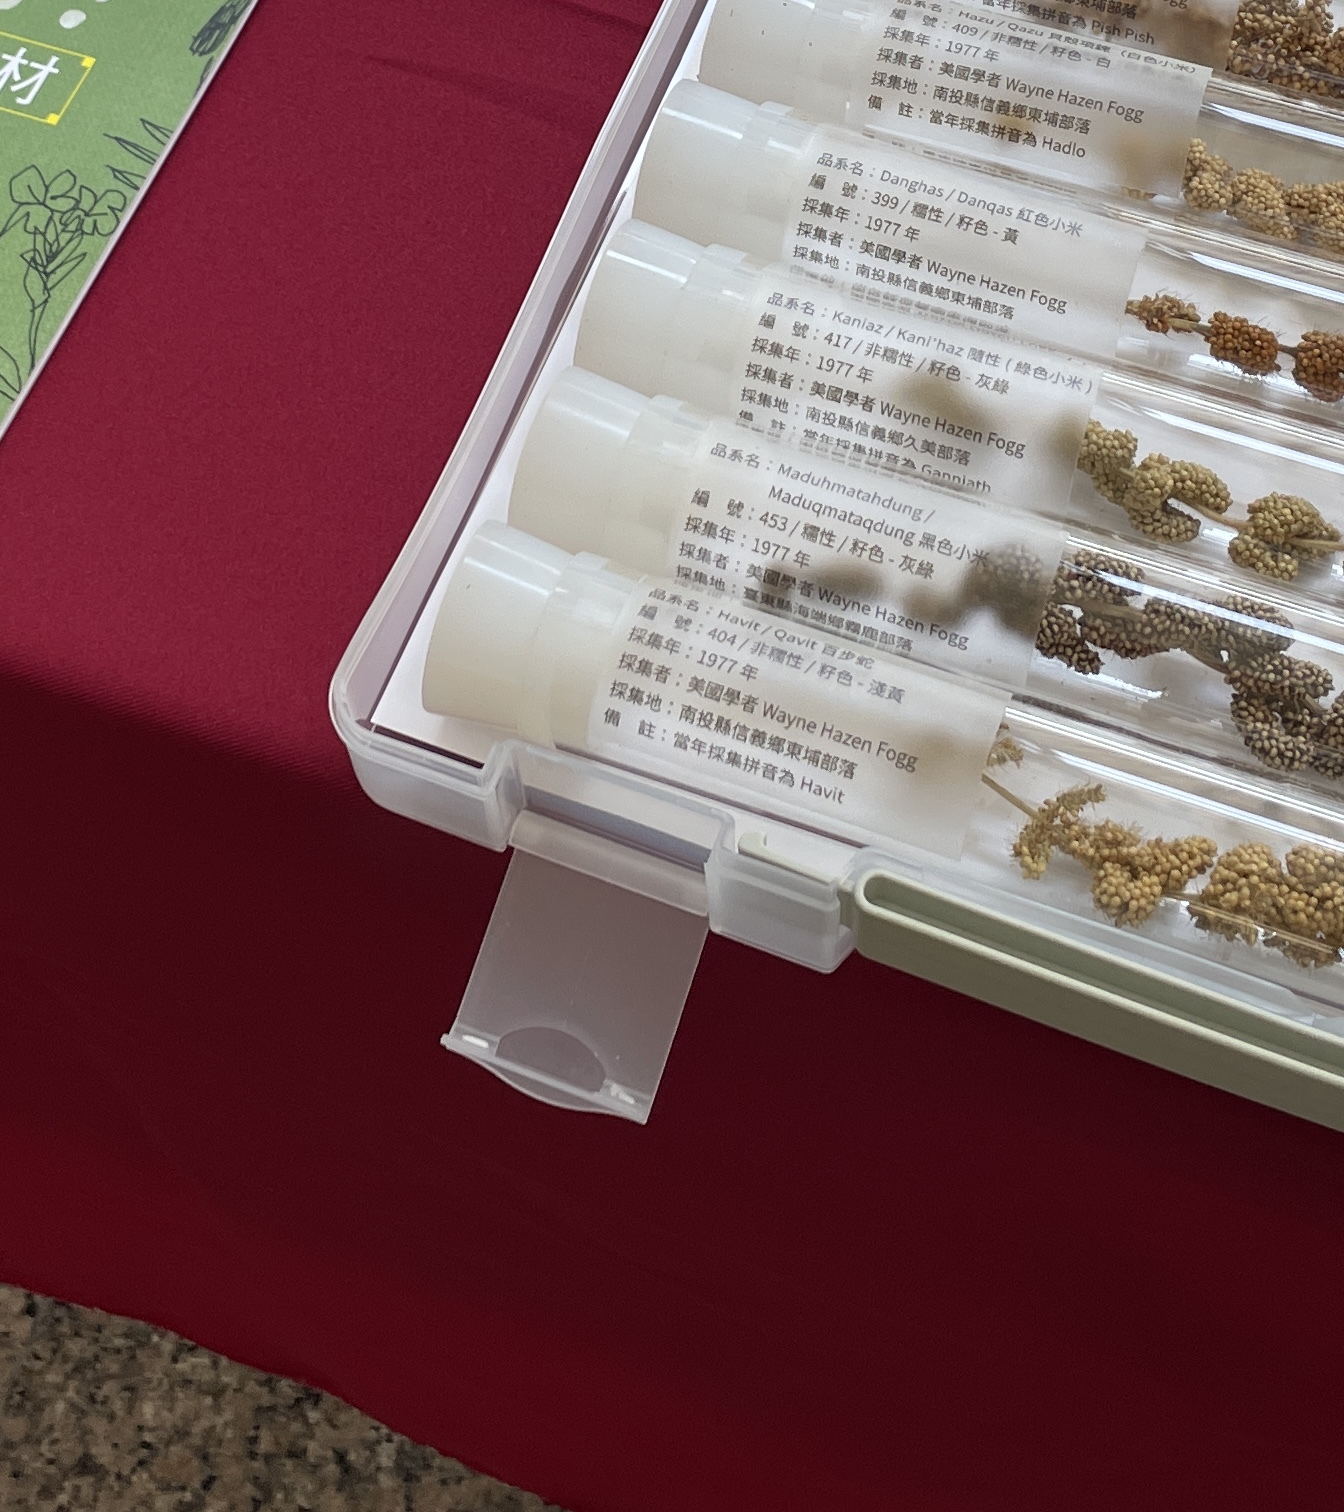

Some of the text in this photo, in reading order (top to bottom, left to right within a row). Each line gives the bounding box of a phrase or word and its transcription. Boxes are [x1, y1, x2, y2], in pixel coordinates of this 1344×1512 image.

[1007, 21, 1044, 38] Qazu
[1092, 19, 1120, 38] Pish
[1125, 26, 1155, 46] Pish
[1097, 55, 1110, 68] 白
[1005, 76, 1054, 100] Wayne
[1058, 88, 1103, 111] Hazen
[1107, 101, 1145, 124] Fogg
[1042, 136, 1086, 158] Hadlo
[957, 190, 1014, 217] Danqas
[1016, 207, 1083, 237] 紅色小米
[1003, 227, 1019, 245] 黃
[926, 258, 976, 285] Wayne
[980, 273, 1025, 299] Hazen
[1030, 287, 1068, 314] Fogg
[975, 372, 1009, 395] 灰綠
[880, 401, 931, 428] Wayne
[934, 416, 982, 442] Hazen
[986, 431, 1026, 458] Fogg
[768, 485, 990, 566] Maduqmataqdung 黑色小米
[900, 553, 935, 579] 灰綠
[818, 582, 871, 614] Wayne
[875, 602, 924, 633] Hazen
[928, 622, 968, 650] Fogg
[774, 628, 817, 651] Qavit
[821, 644, 875, 669] 百步蛇
[867, 679, 905, 704] 淺黃
[762, 701, 816, 734] Wayne
[820, 722, 872, 752] Hazen
[876, 743, 918, 772] Fogg
[800, 776, 846, 804] Havit
